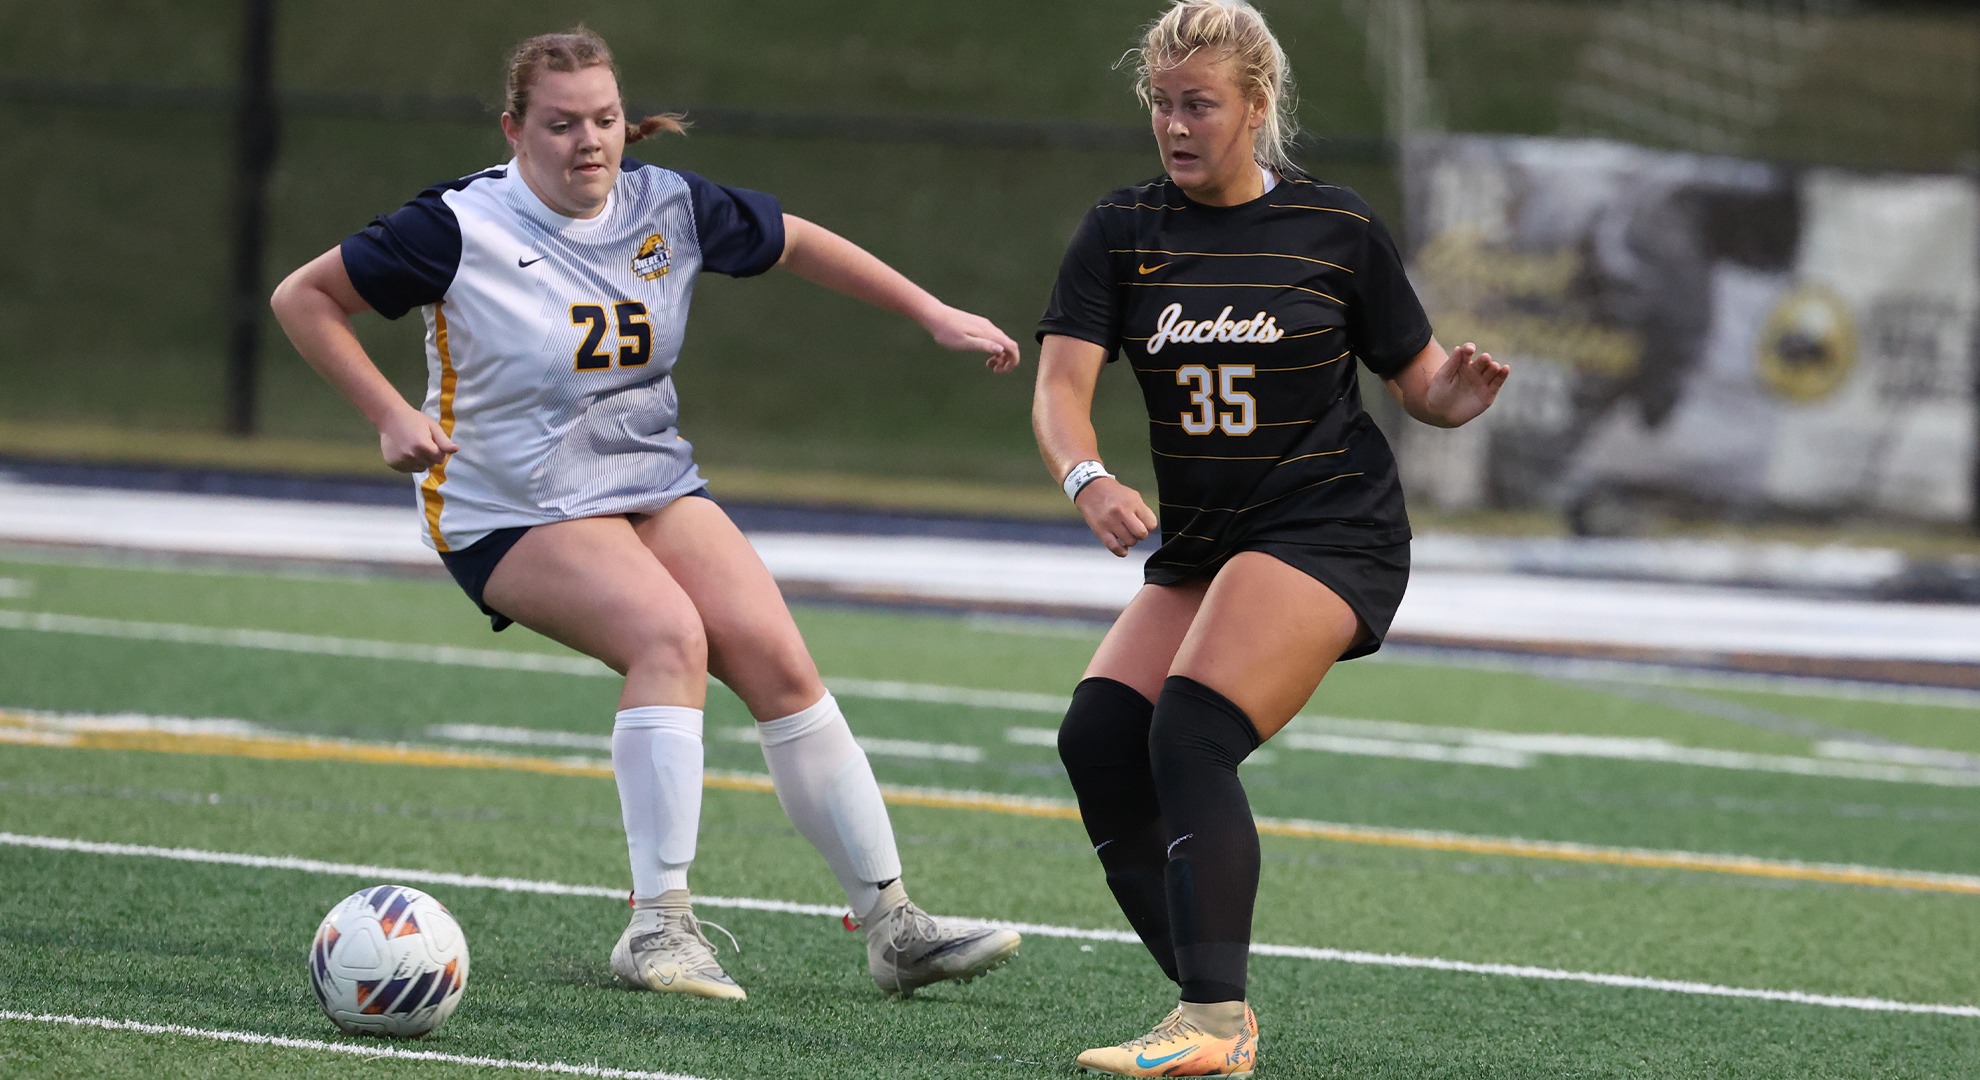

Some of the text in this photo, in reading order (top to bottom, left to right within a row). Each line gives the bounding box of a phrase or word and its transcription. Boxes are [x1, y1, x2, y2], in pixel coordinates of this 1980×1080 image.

[633, 249, 671, 271] AVERETT
[569, 300, 653, 372] 25
[1146, 302, 1284, 354] Jackets
[1176, 364, 1256, 436] 35
